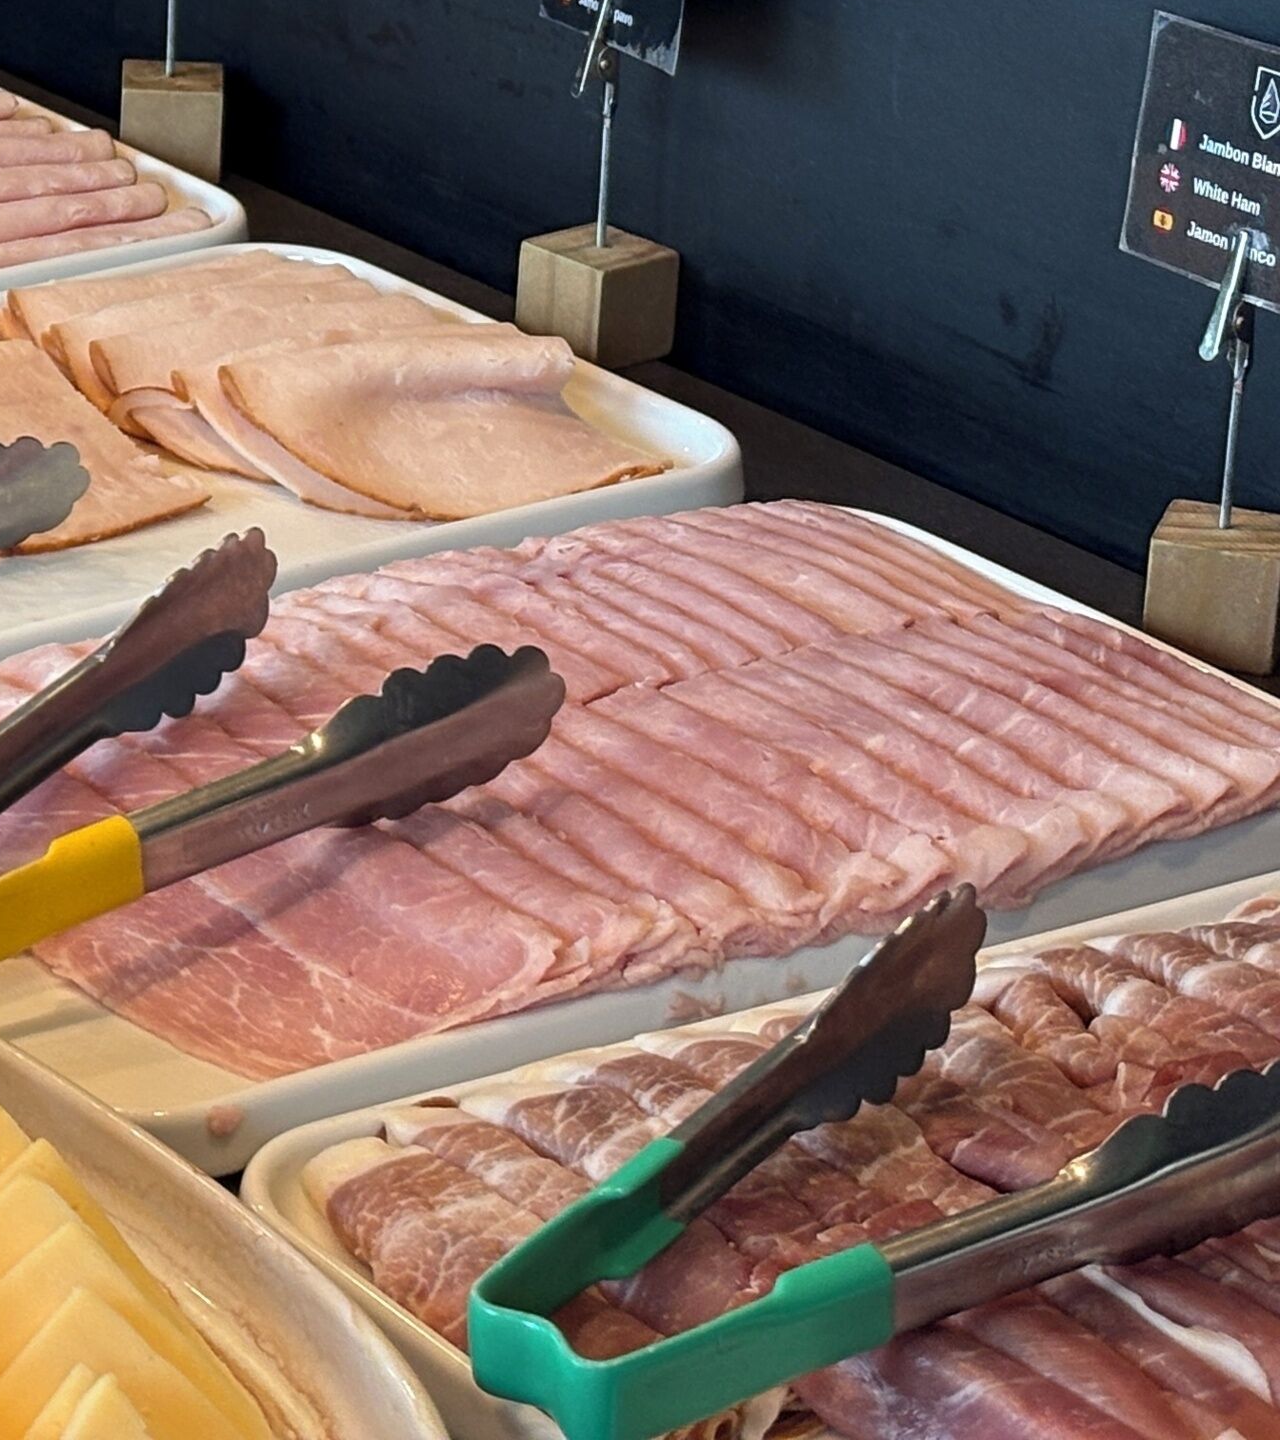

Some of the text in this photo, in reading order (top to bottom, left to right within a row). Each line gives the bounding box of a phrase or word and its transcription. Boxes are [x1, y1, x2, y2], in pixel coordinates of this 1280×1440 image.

[613, 9, 633, 27] pavo
[1198, 133, 1280, 178] Jambon Blan
[1193, 177, 1261, 217] White Ham
[1187, 220, 1228, 251] Jamon
